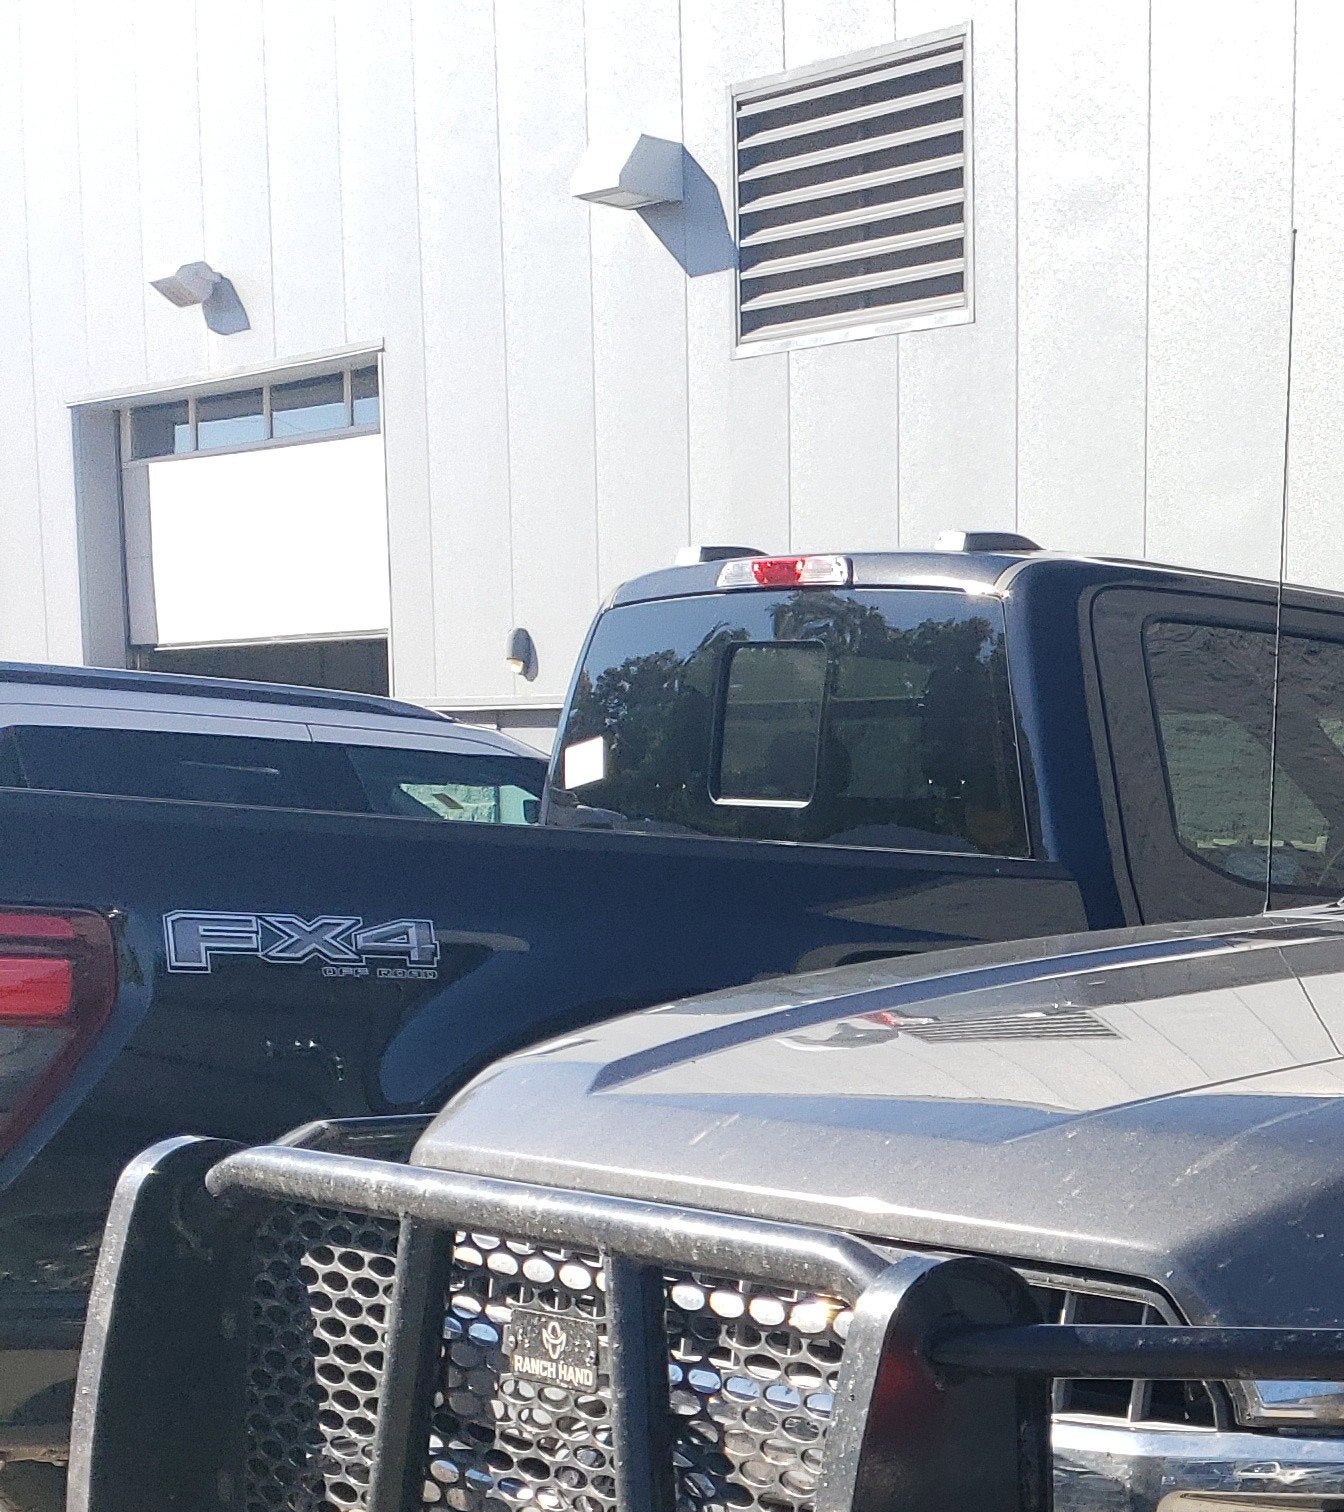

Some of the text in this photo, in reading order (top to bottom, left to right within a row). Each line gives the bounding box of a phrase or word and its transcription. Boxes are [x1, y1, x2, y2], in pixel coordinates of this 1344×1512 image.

[163, 910, 440, 973] FX4
[322, 967, 438, 979] OFF ROAD
[513, 1354, 593, 1386] RANCH HAND
